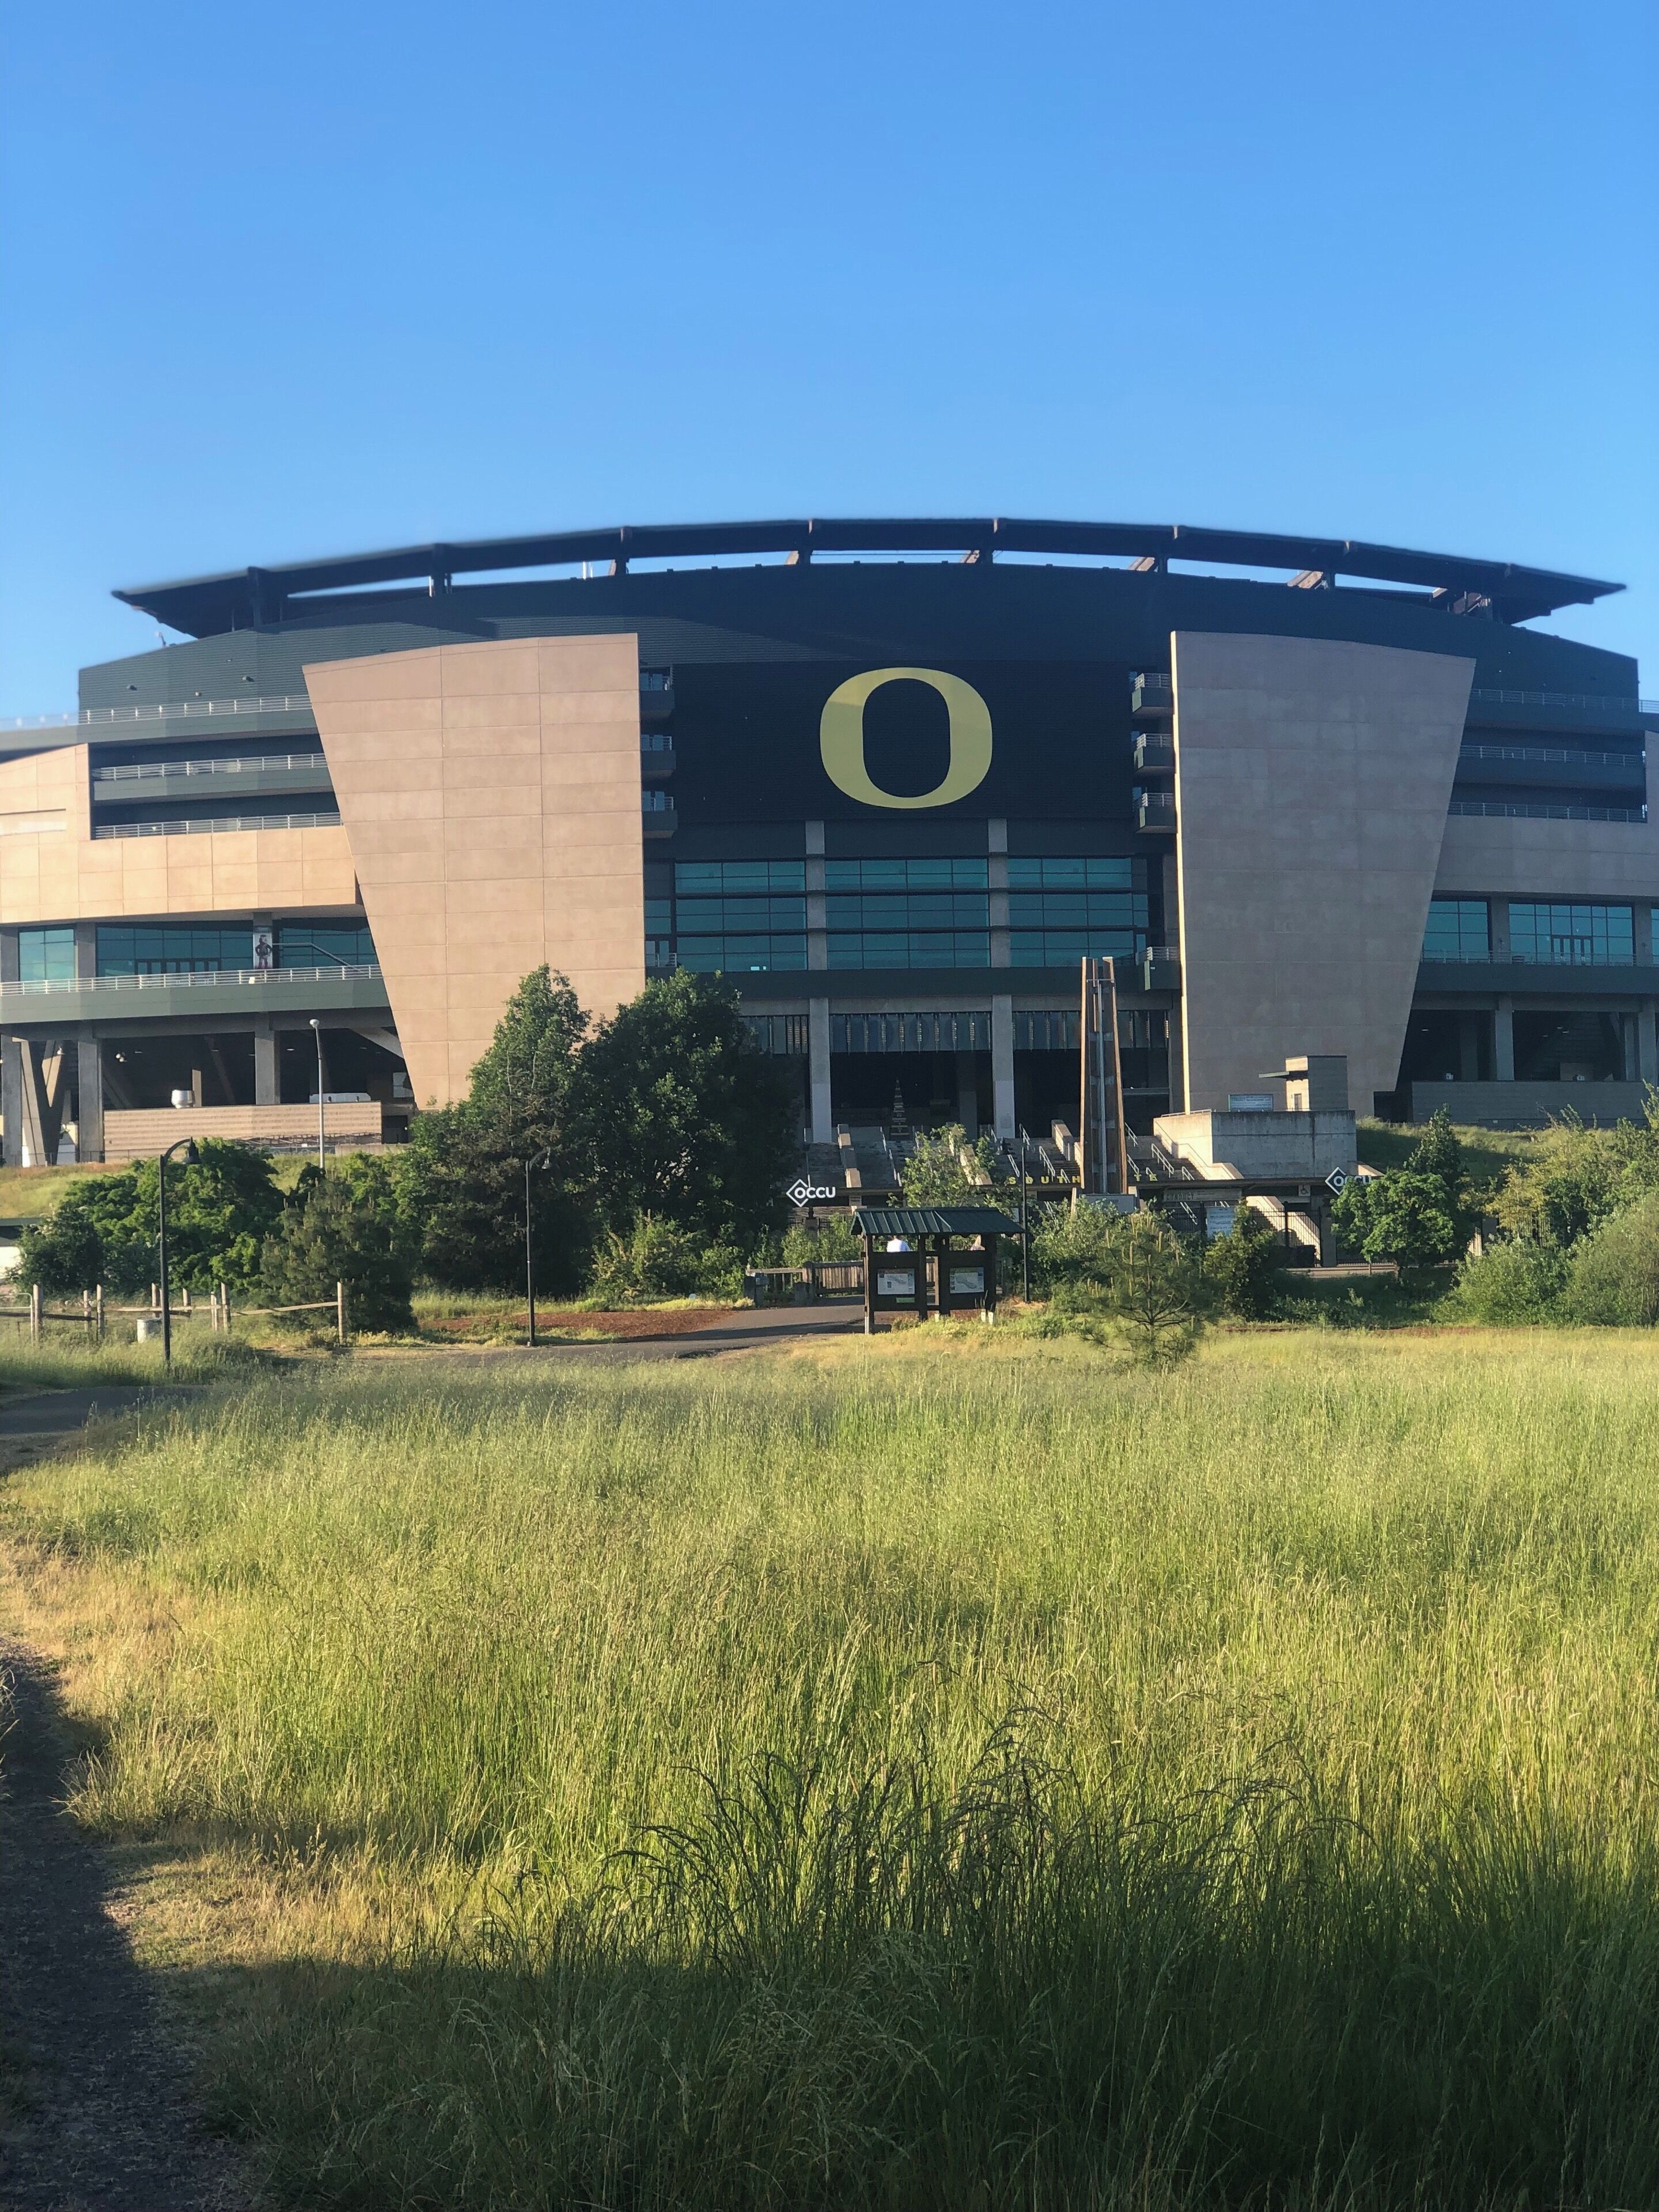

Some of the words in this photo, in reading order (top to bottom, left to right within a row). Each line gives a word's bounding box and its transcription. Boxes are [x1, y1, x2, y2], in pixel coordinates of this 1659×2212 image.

[819, 667, 993, 809] O
[1009, 1176, 1081, 1184] SOUTH
[794, 1187, 835, 1198] OCCU
